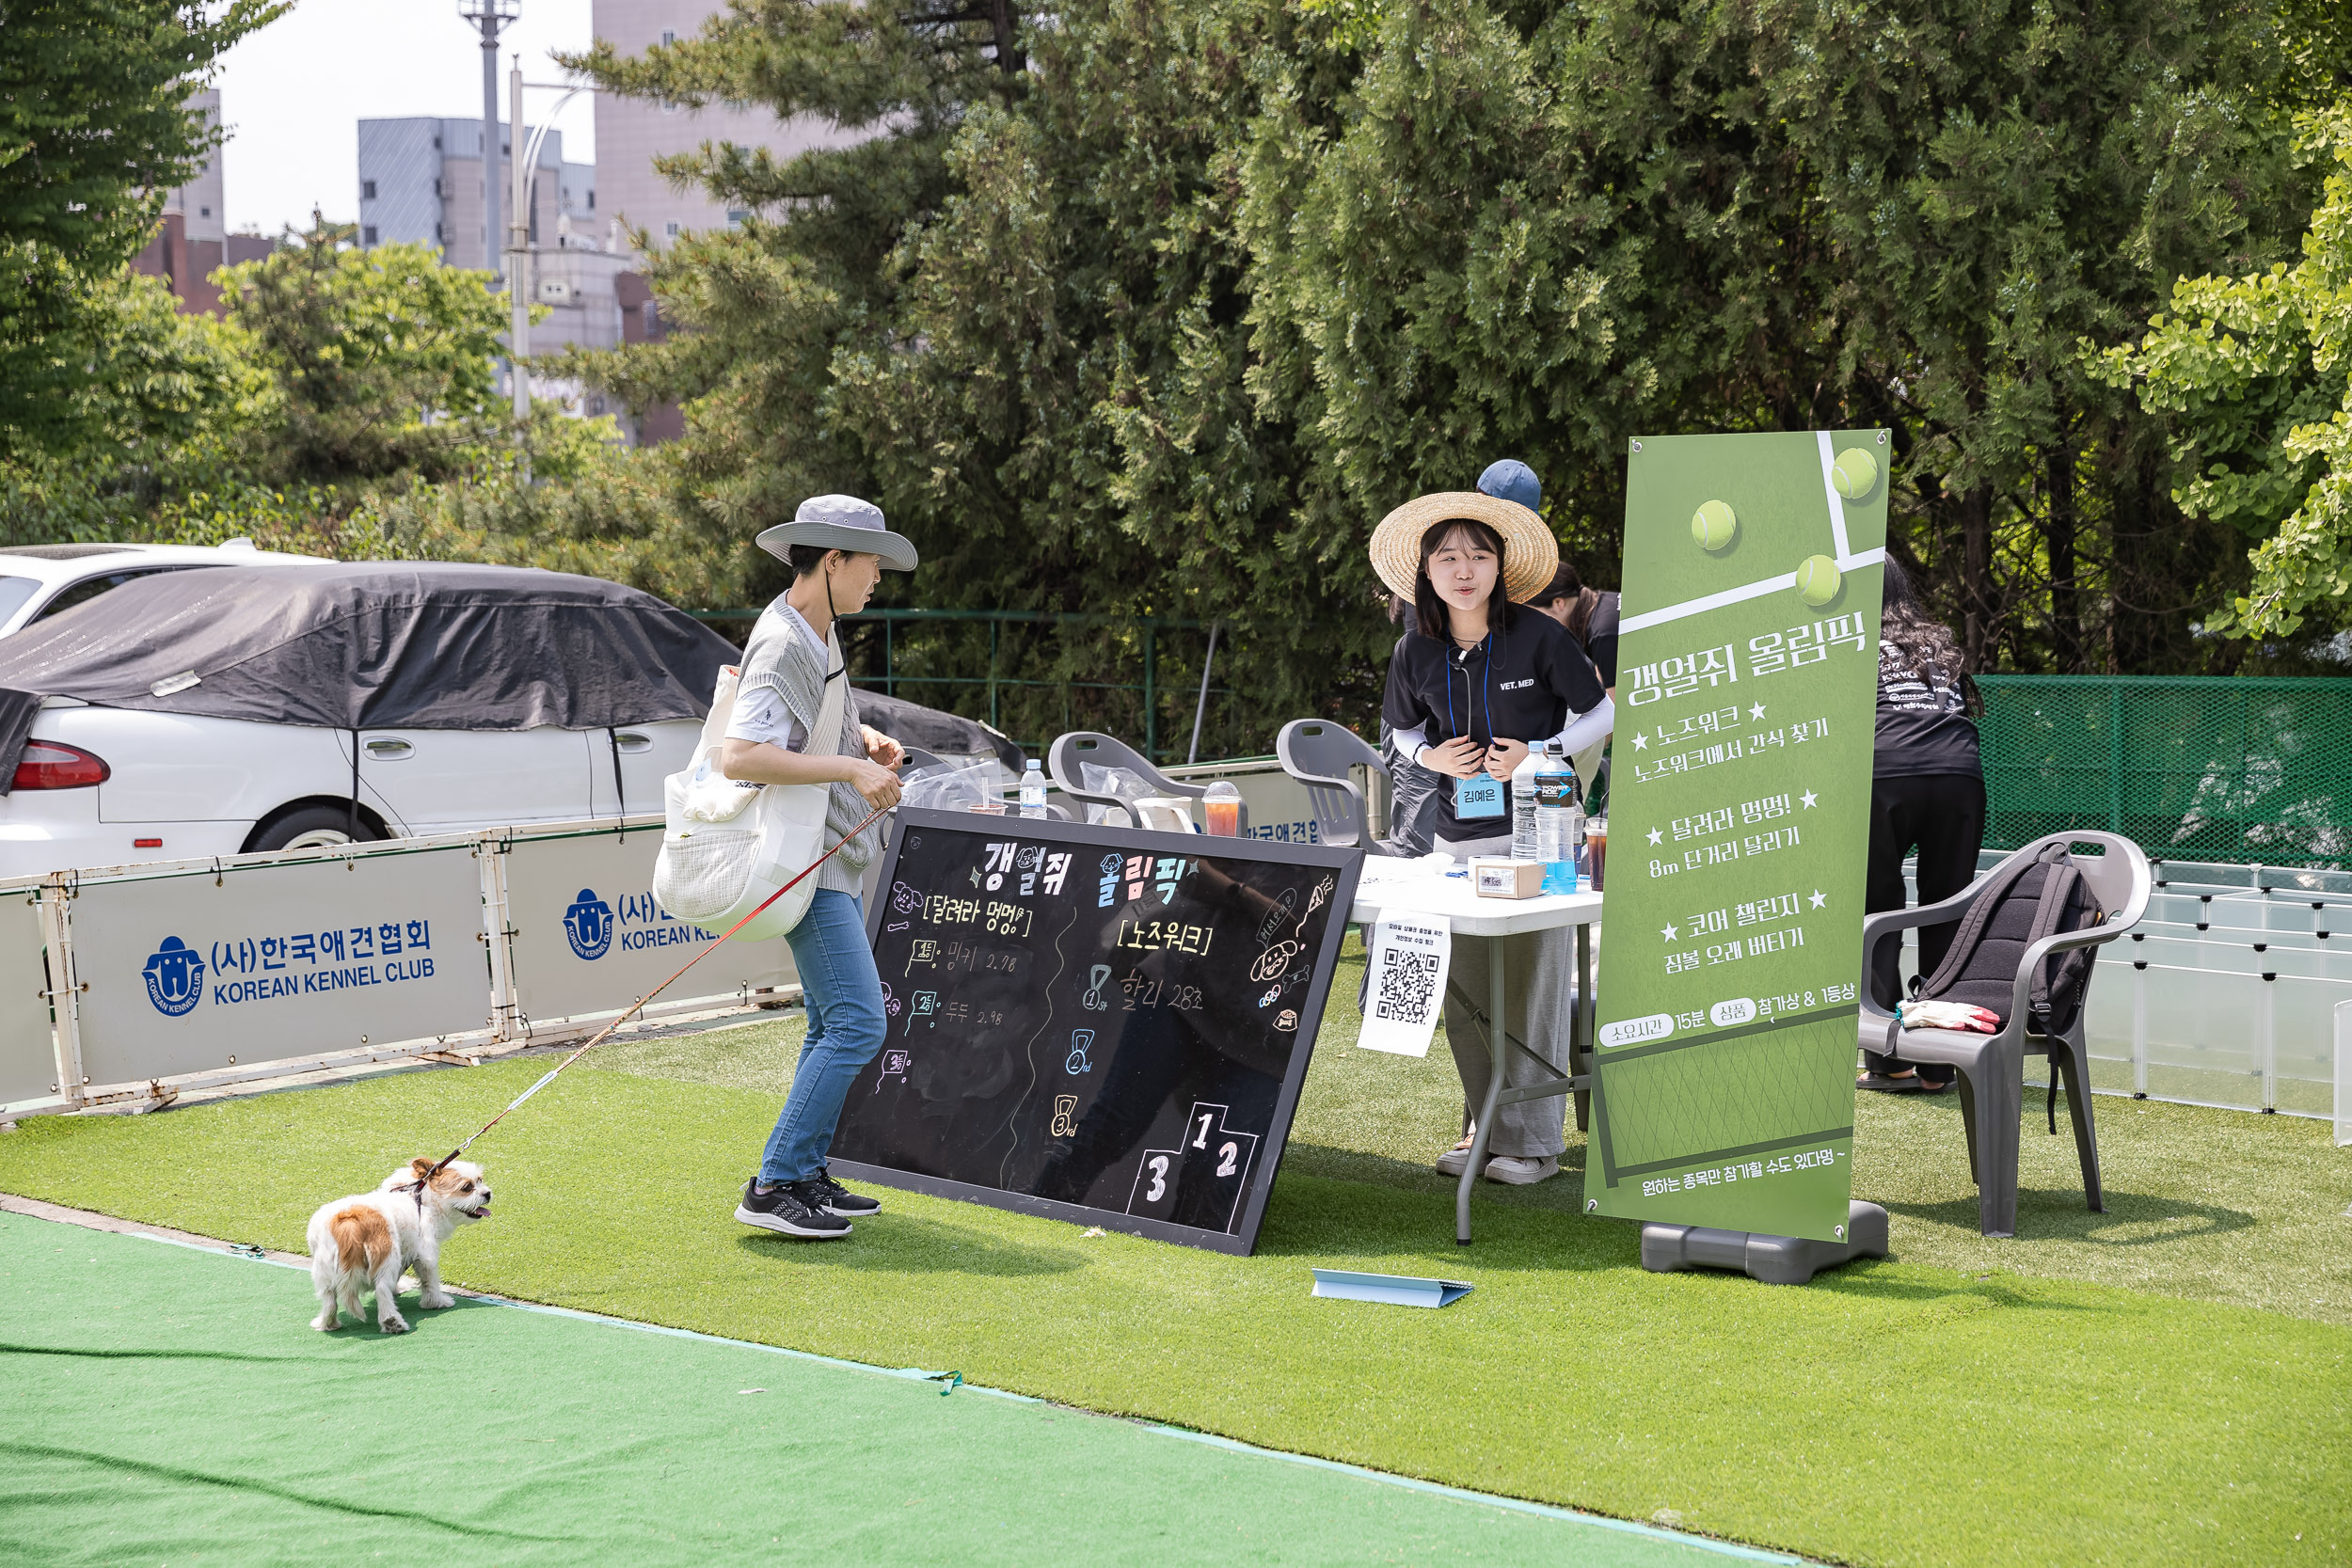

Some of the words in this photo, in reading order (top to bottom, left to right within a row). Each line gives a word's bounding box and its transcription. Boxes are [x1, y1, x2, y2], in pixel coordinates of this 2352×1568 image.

[1623, 643, 1738, 706] 갱얼쥐
[1748, 611, 1866, 677] 올림픽
[1500, 681, 1518, 690] VET.
[1518, 678, 1534, 688] MED
[1657, 705, 1740, 746] 노즈워크
[1634, 739, 1742, 784] 노즈워크에서
[1747, 729, 1785, 755] 간식
[1789, 718, 1829, 744] 찾기
[1464, 788, 1495, 803] 김예은
[1671, 806, 1735, 842] 달려라
[1740, 793, 1791, 825] 멍멍!
[1649, 859, 1679, 879] 8m
[1684, 840, 1740, 871] 단거리
[1744, 826, 1801, 857] 달리기
[1098, 852, 1186, 908] 올림픽
[621, 926, 691, 951] KOREAN
[1687, 908, 1729, 938] 코어
[1734, 892, 1801, 927] 챌린지
[212, 920, 431, 976] (사)한국애견협회
[1663, 949, 1700, 974] 짐볼
[1706, 940, 1743, 966] 오래
[1748, 927, 1804, 957] 버티기
[148, 977, 169, 1011] KOREAN
[168, 996, 197, 1013] KENNEL
[192, 972, 201, 996] CLUB
[214, 974, 298, 1005] KOREAN
[304, 965, 381, 993] KENNEL
[385, 958, 435, 982] CLUB
[1611, 1019, 1662, 1042] 소요시간
[1675, 1009, 1707, 1031] 15분
[1719, 1002, 1747, 1022] 상품
[1757, 992, 1800, 1016] 참가상
[1804, 990, 1817, 1007] &
[1820, 982, 1856, 1004] 1등상
[1192, 1113, 1214, 1149] 1
[1146, 1155, 1169, 1202] 3
[1216, 1141, 1238, 1178] 2
[1642, 1177, 1681, 1197] 원하는
[1683, 1168, 1722, 1190] 종목만
[1723, 1161, 1763, 1183] 참가할
[1765, 1156, 1792, 1175] 수도
